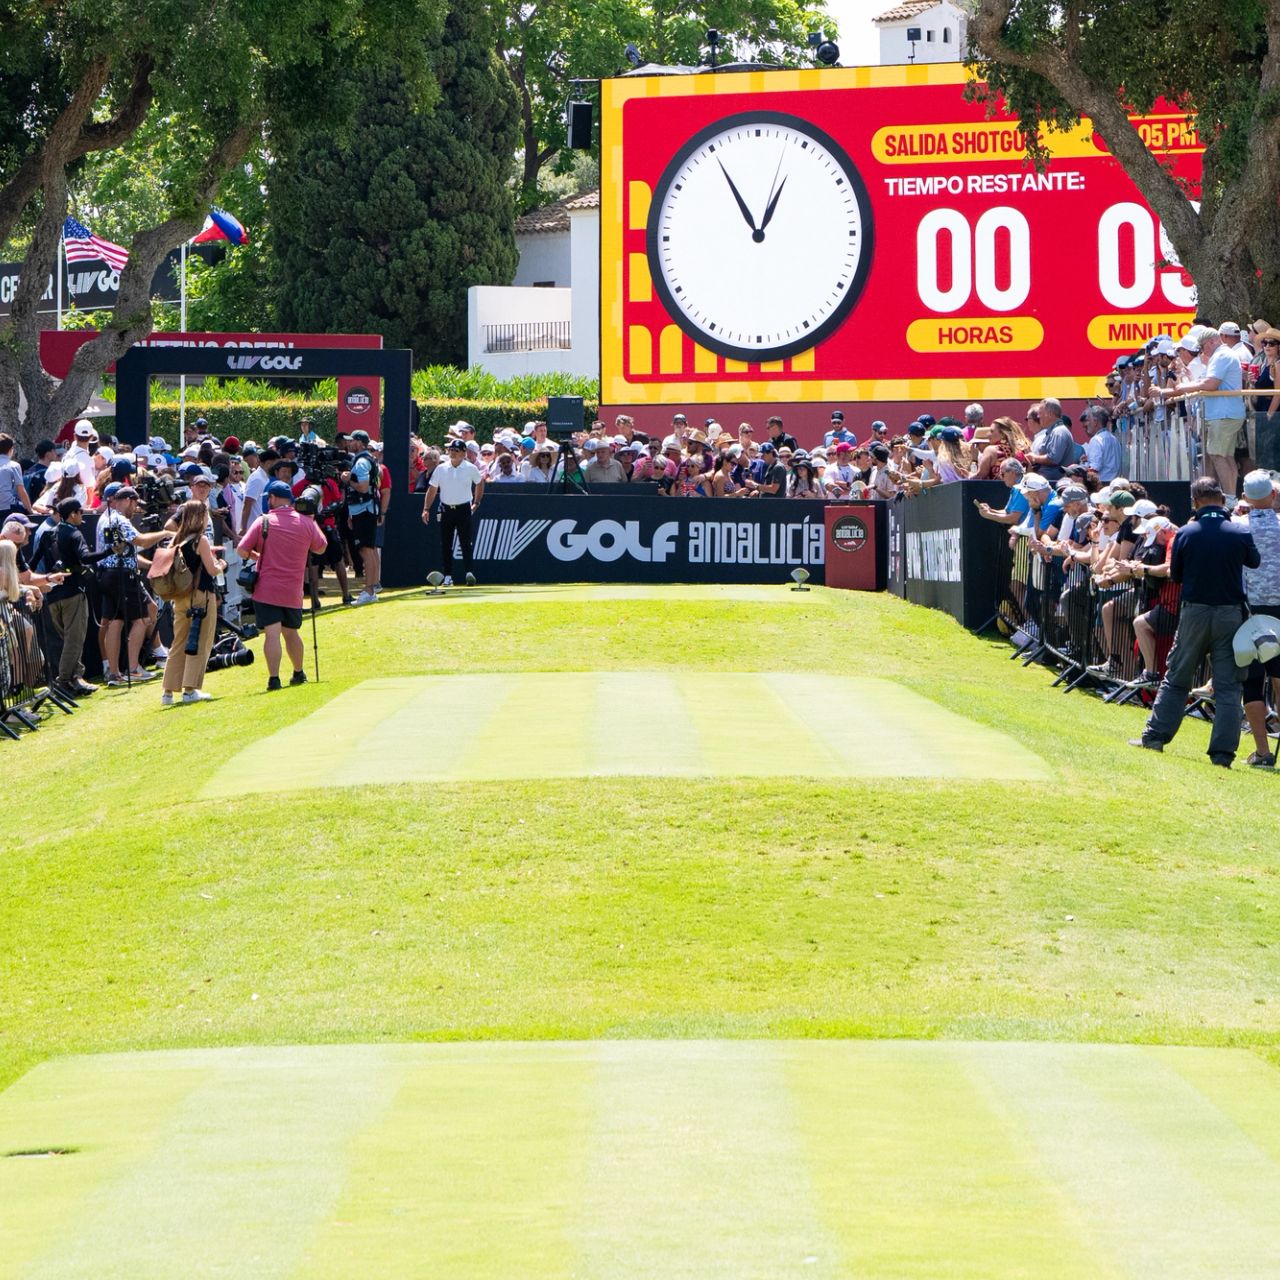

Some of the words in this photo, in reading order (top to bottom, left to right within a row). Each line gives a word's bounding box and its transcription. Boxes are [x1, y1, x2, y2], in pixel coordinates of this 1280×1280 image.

[884, 132, 949, 157] SALIDA
[951, 128, 1044, 154] SHOTGU
[1137, 123, 1164, 147] 05
[1166, 122, 1197, 146] PM
[884, 175, 963, 196] TIEMPO
[967, 171, 1086, 193] RESTANTE:
[916, 206, 1031, 313] 00
[937, 325, 1014, 345] HORAS
[1108, 322, 1194, 342] MINUTO
[226, 355, 262, 370] LIV
[260, 355, 303, 370] GOLF
[546, 518, 680, 563] GOLF
